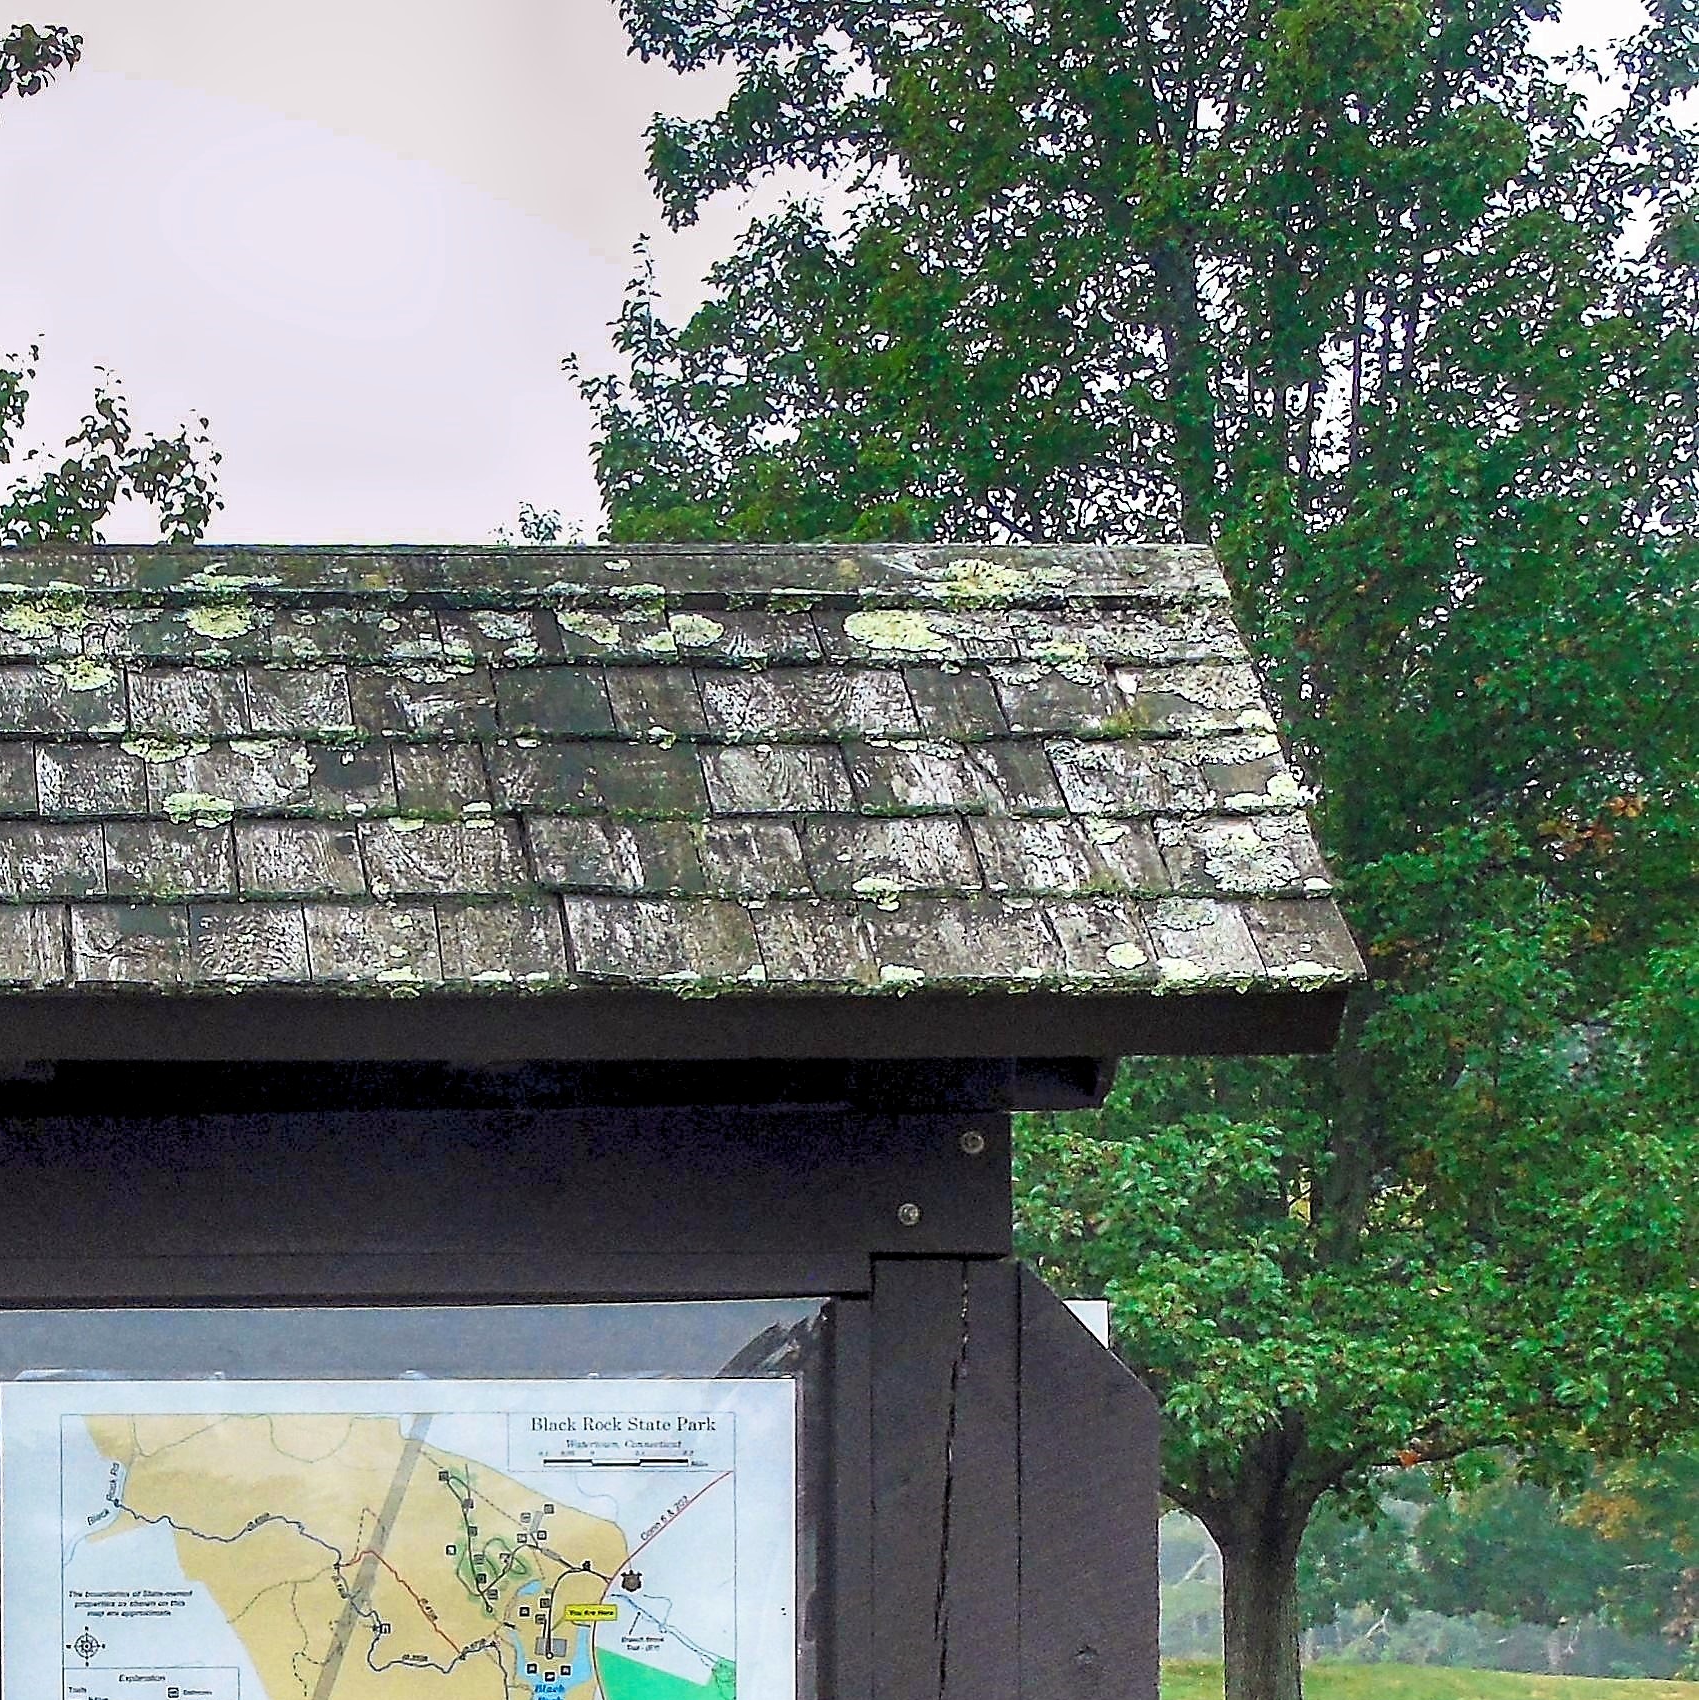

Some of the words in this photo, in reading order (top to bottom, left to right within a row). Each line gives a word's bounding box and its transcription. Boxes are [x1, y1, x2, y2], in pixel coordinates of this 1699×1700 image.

[532, 1417, 576, 1431] Black
[584, 1417, 621, 1430] Rock
[628, 1418, 670, 1431] State
[678, 1417, 716, 1431] Park
[535, 1684, 565, 1693] Black
